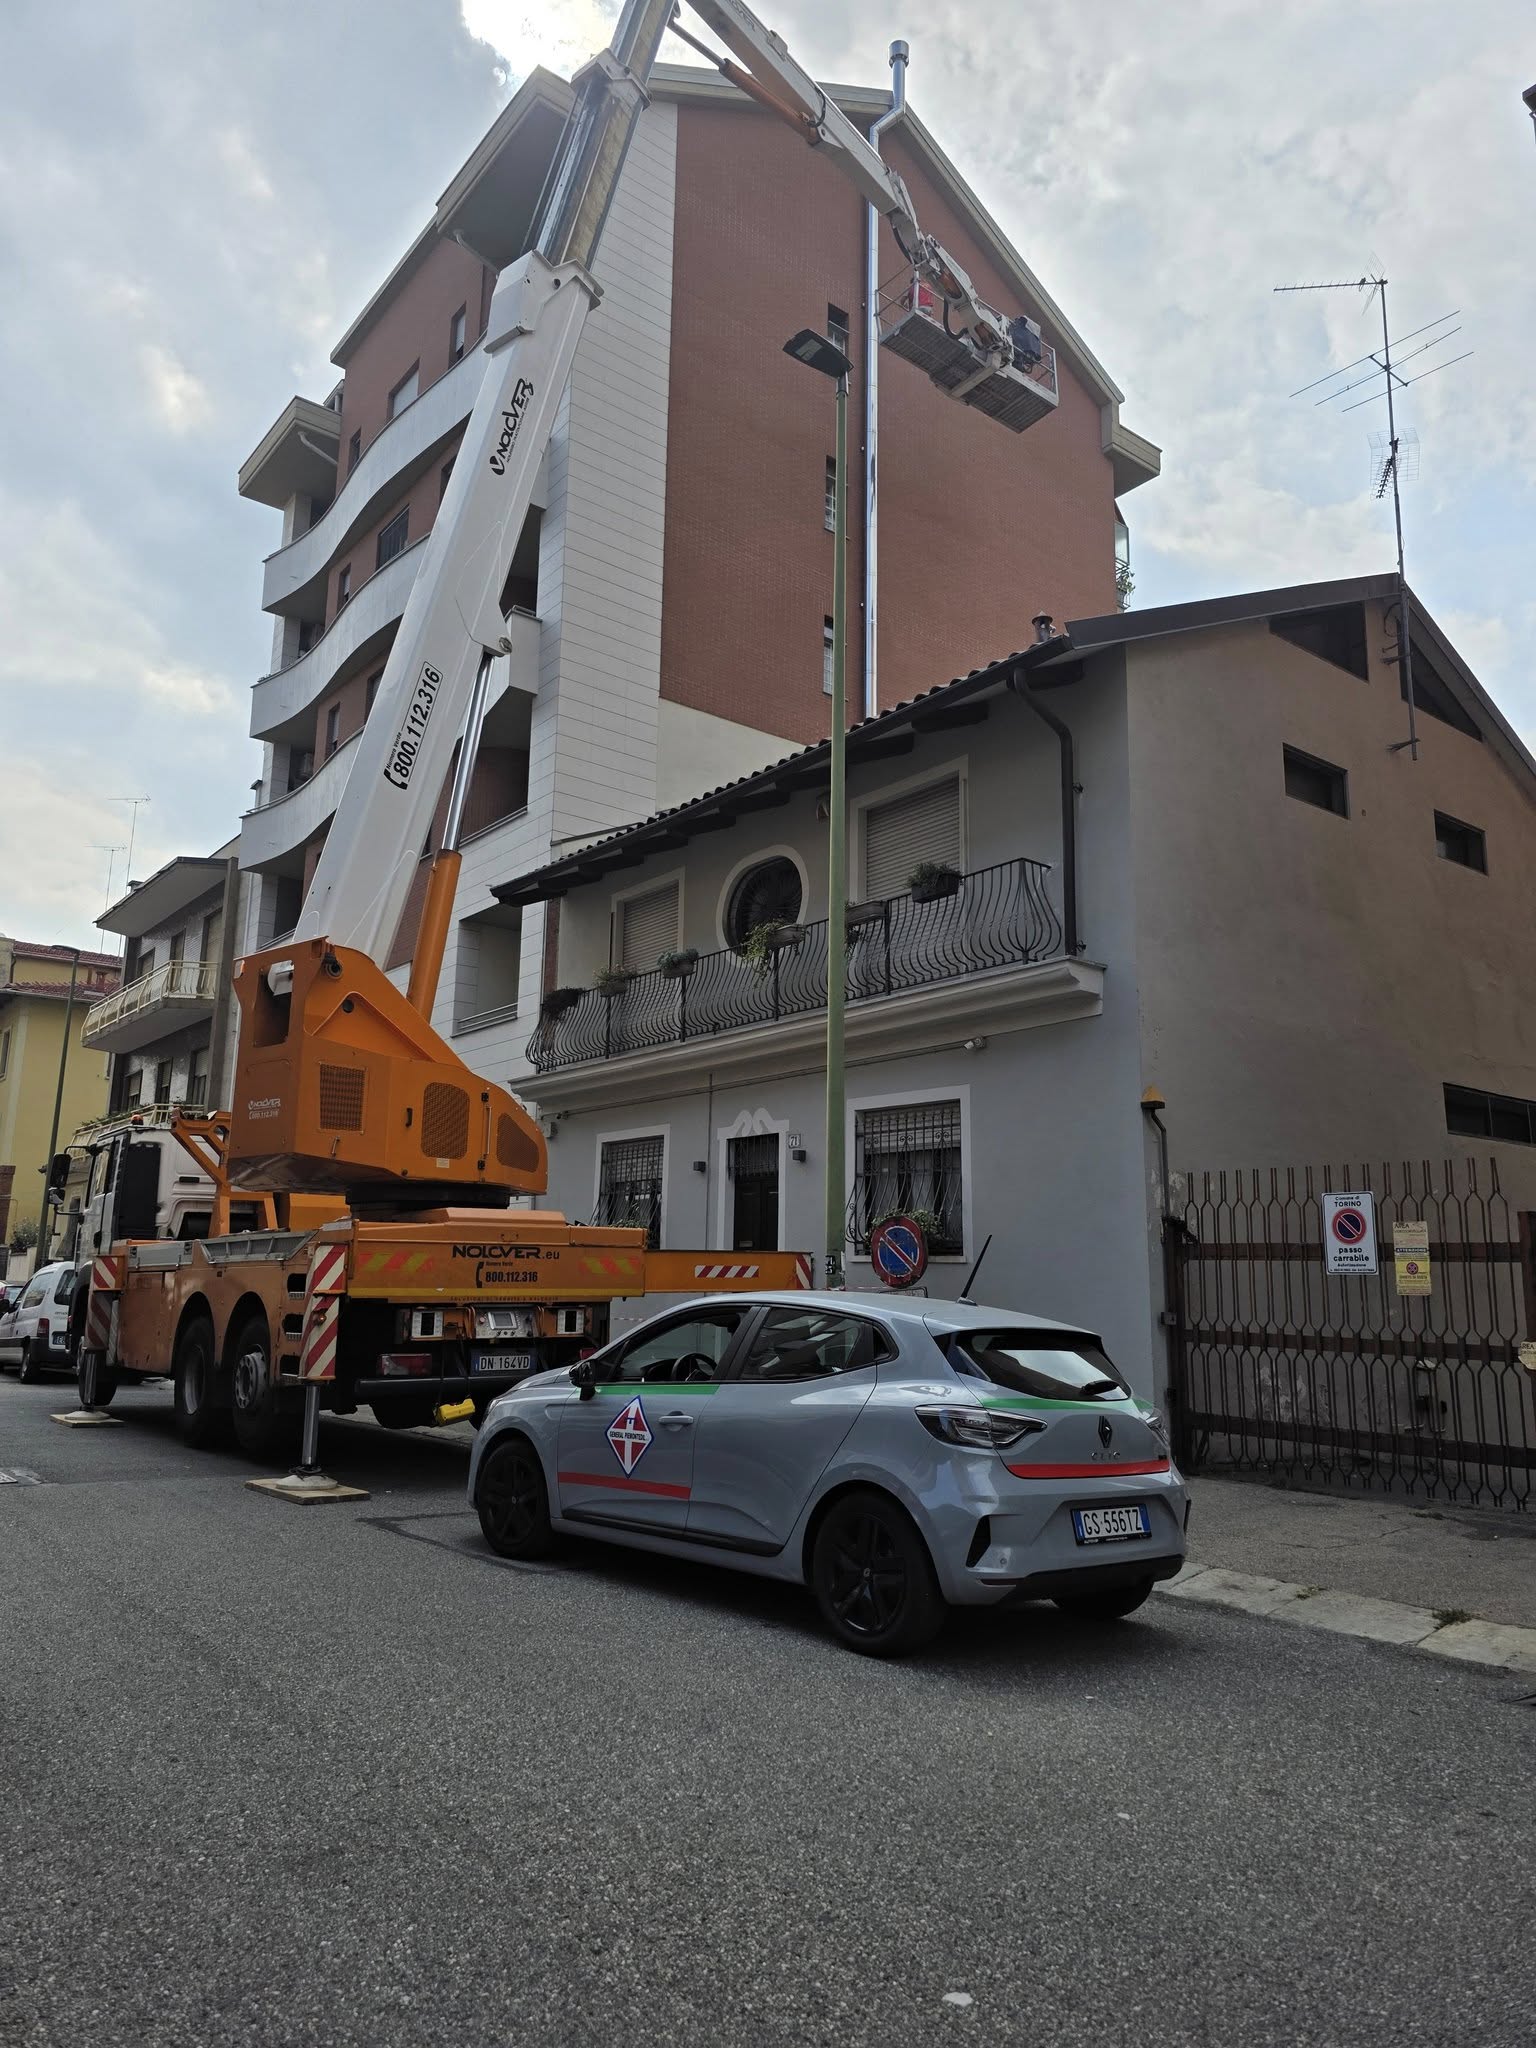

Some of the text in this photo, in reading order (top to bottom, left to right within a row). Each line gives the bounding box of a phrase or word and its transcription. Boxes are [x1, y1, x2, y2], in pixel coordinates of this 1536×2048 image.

[393, 667, 440, 778] 800.112.316
[790, 1135, 798, 1146] 71
[1334, 1200, 1362, 1208] TORINO
[1338, 1247, 1362, 1255] passo
[1333, 1254, 1370, 1262] carrabile
[485, 1271, 538, 1283] 800.112.316
[480, 1356, 530, 1370] DN 164VD
[1082, 1509, 1143, 1536] GS 556TZ
